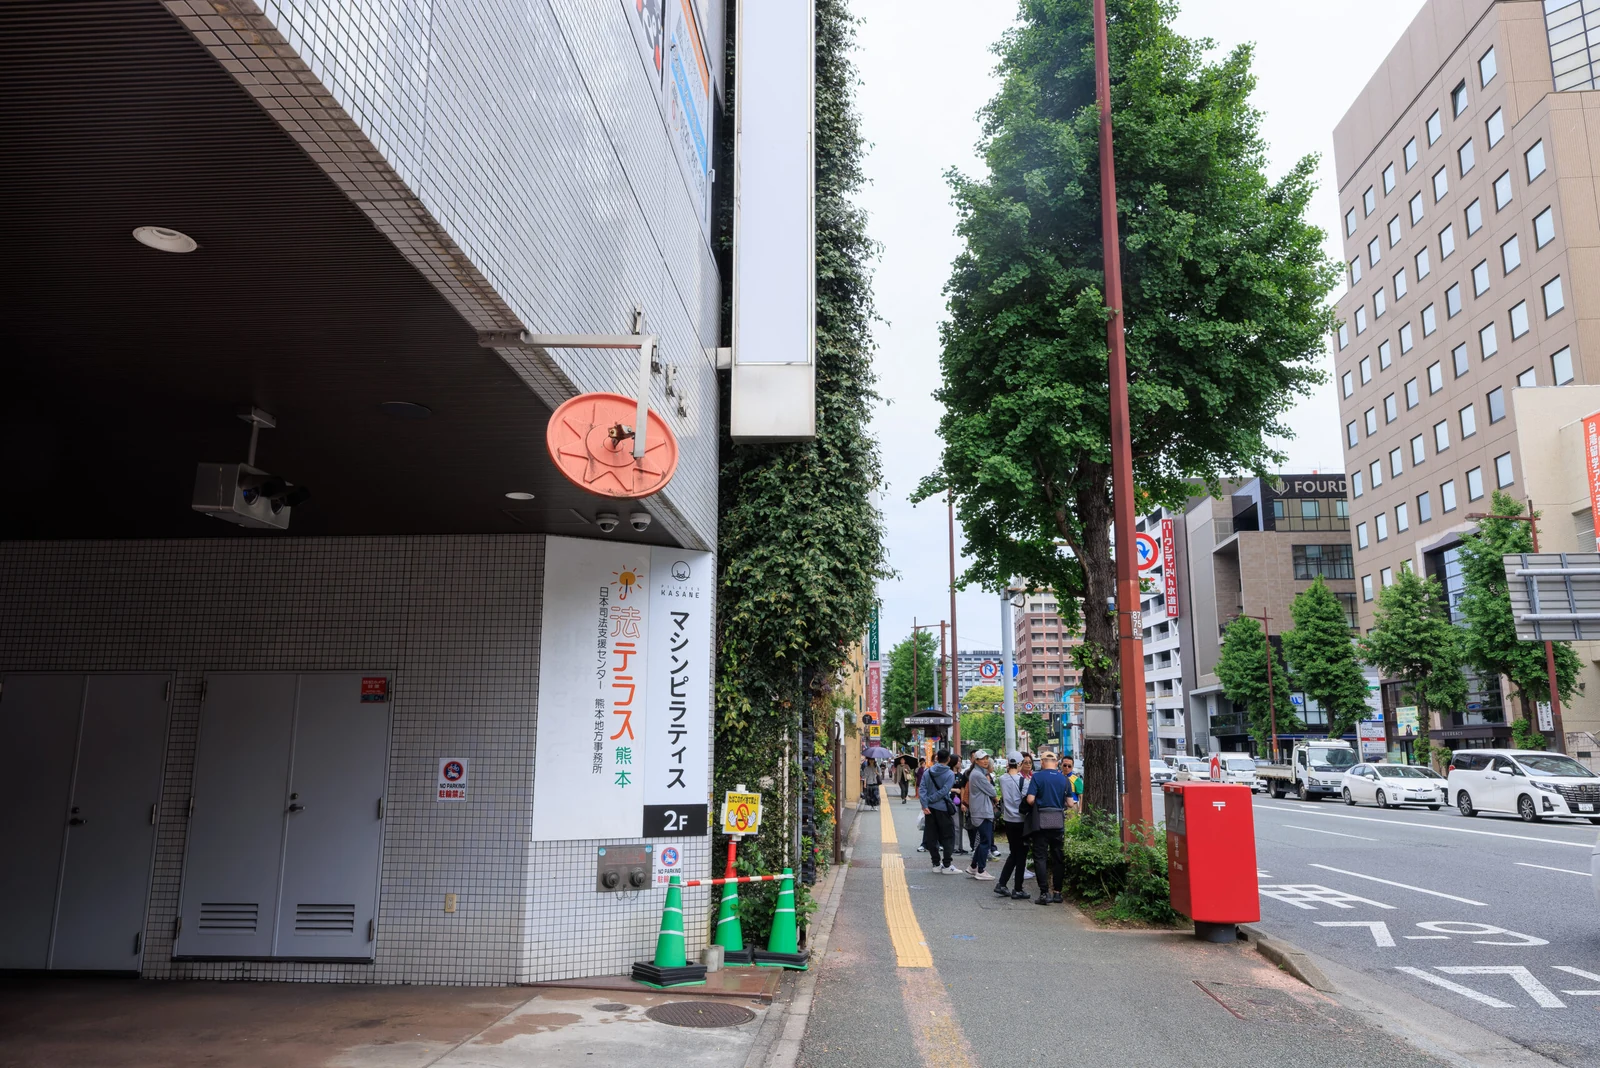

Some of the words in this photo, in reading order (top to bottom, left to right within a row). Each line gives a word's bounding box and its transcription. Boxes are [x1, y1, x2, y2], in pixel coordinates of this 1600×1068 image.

[660, 589, 700, 599] KASANE
[1132, 611, 1141, 619] 87
[1133, 620, 1142, 628] 75
[595, 586, 609, 690] 日本司法支援センター
[666, 610, 690, 789] マシンピラティス
[871, 726, 879, 735] 酒
[592, 698, 605, 774] 熊本地方事務所
[438, 790, 465, 799] 駐輪禁止
[662, 811, 689, 832] 2F
